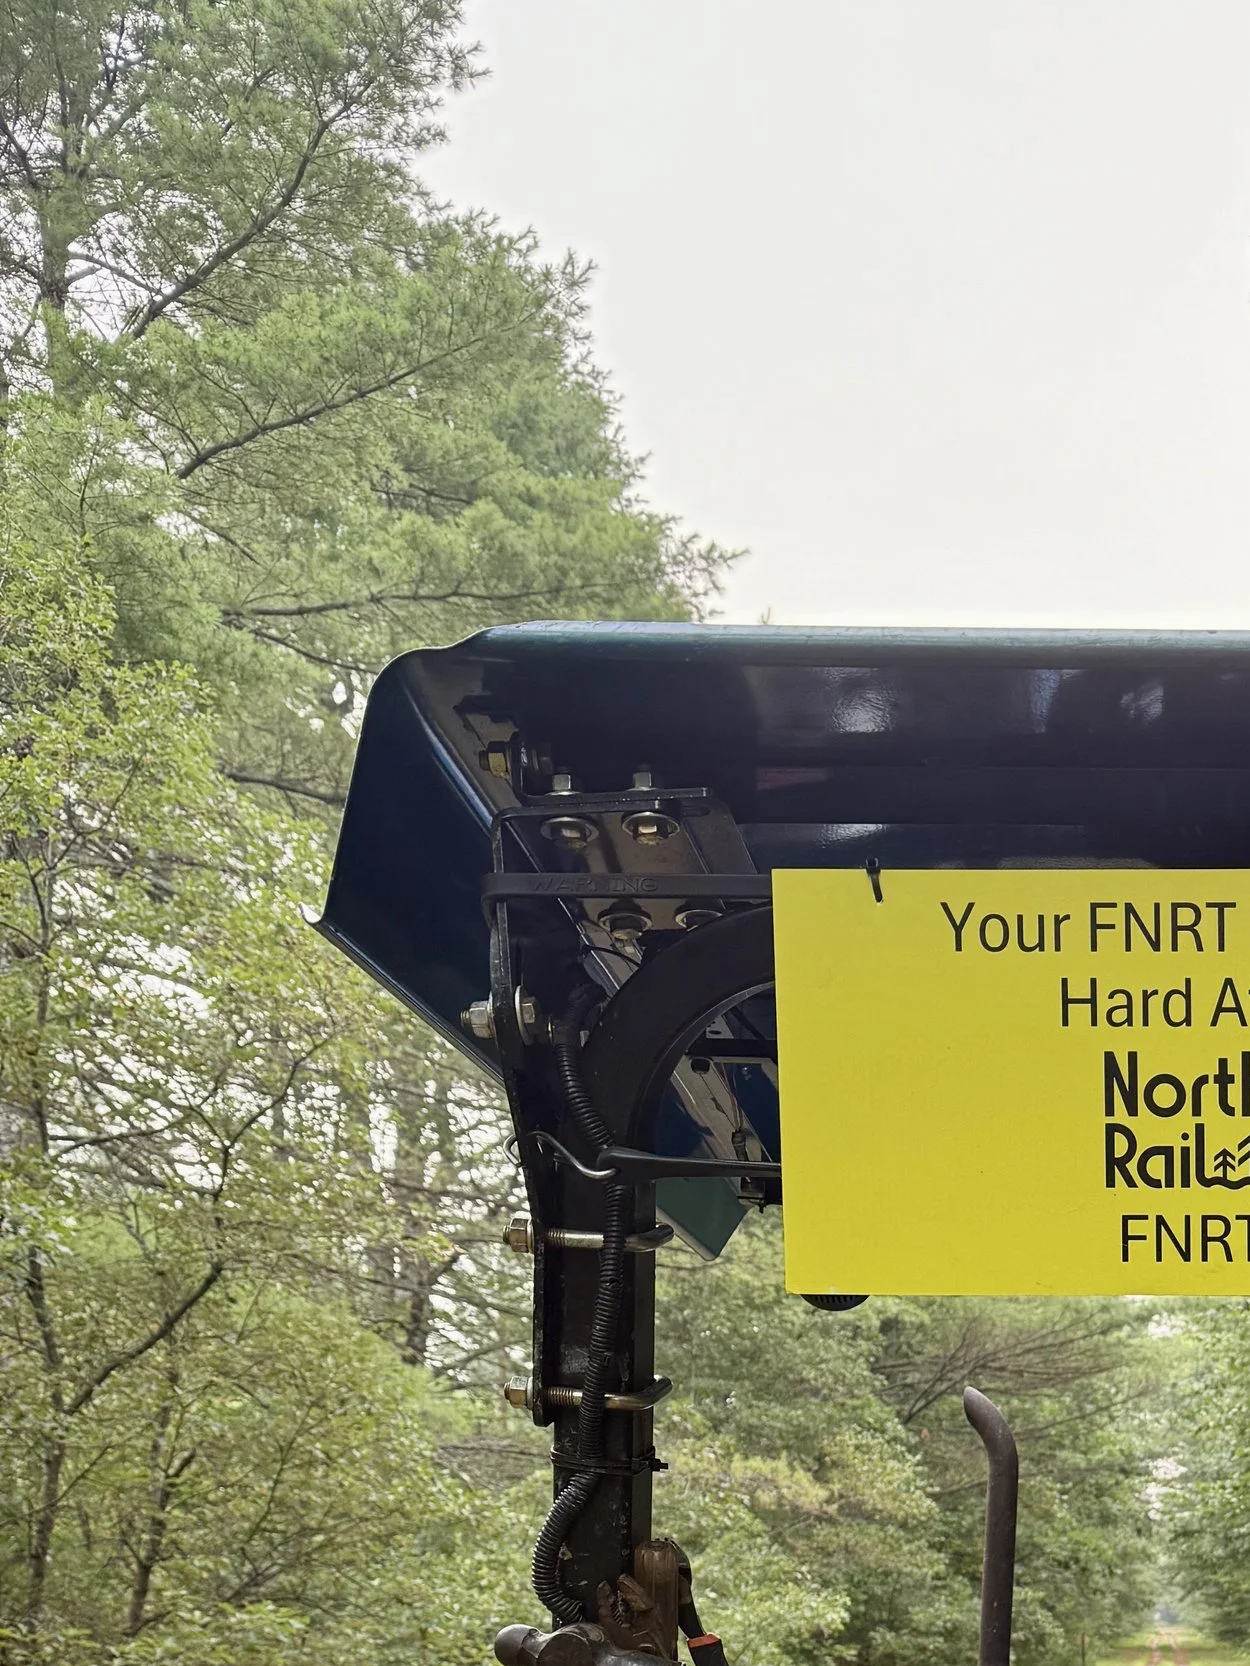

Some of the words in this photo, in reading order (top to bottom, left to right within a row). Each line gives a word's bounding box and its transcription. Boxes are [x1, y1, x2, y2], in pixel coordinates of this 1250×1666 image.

[533, 877, 659, 892] WARING
[940, 901, 1070, 953] Your
[1089, 901, 1237, 953] FNRT
[1061, 977, 1192, 1028] Hard
[1104, 1121, 1212, 1190] Rail
